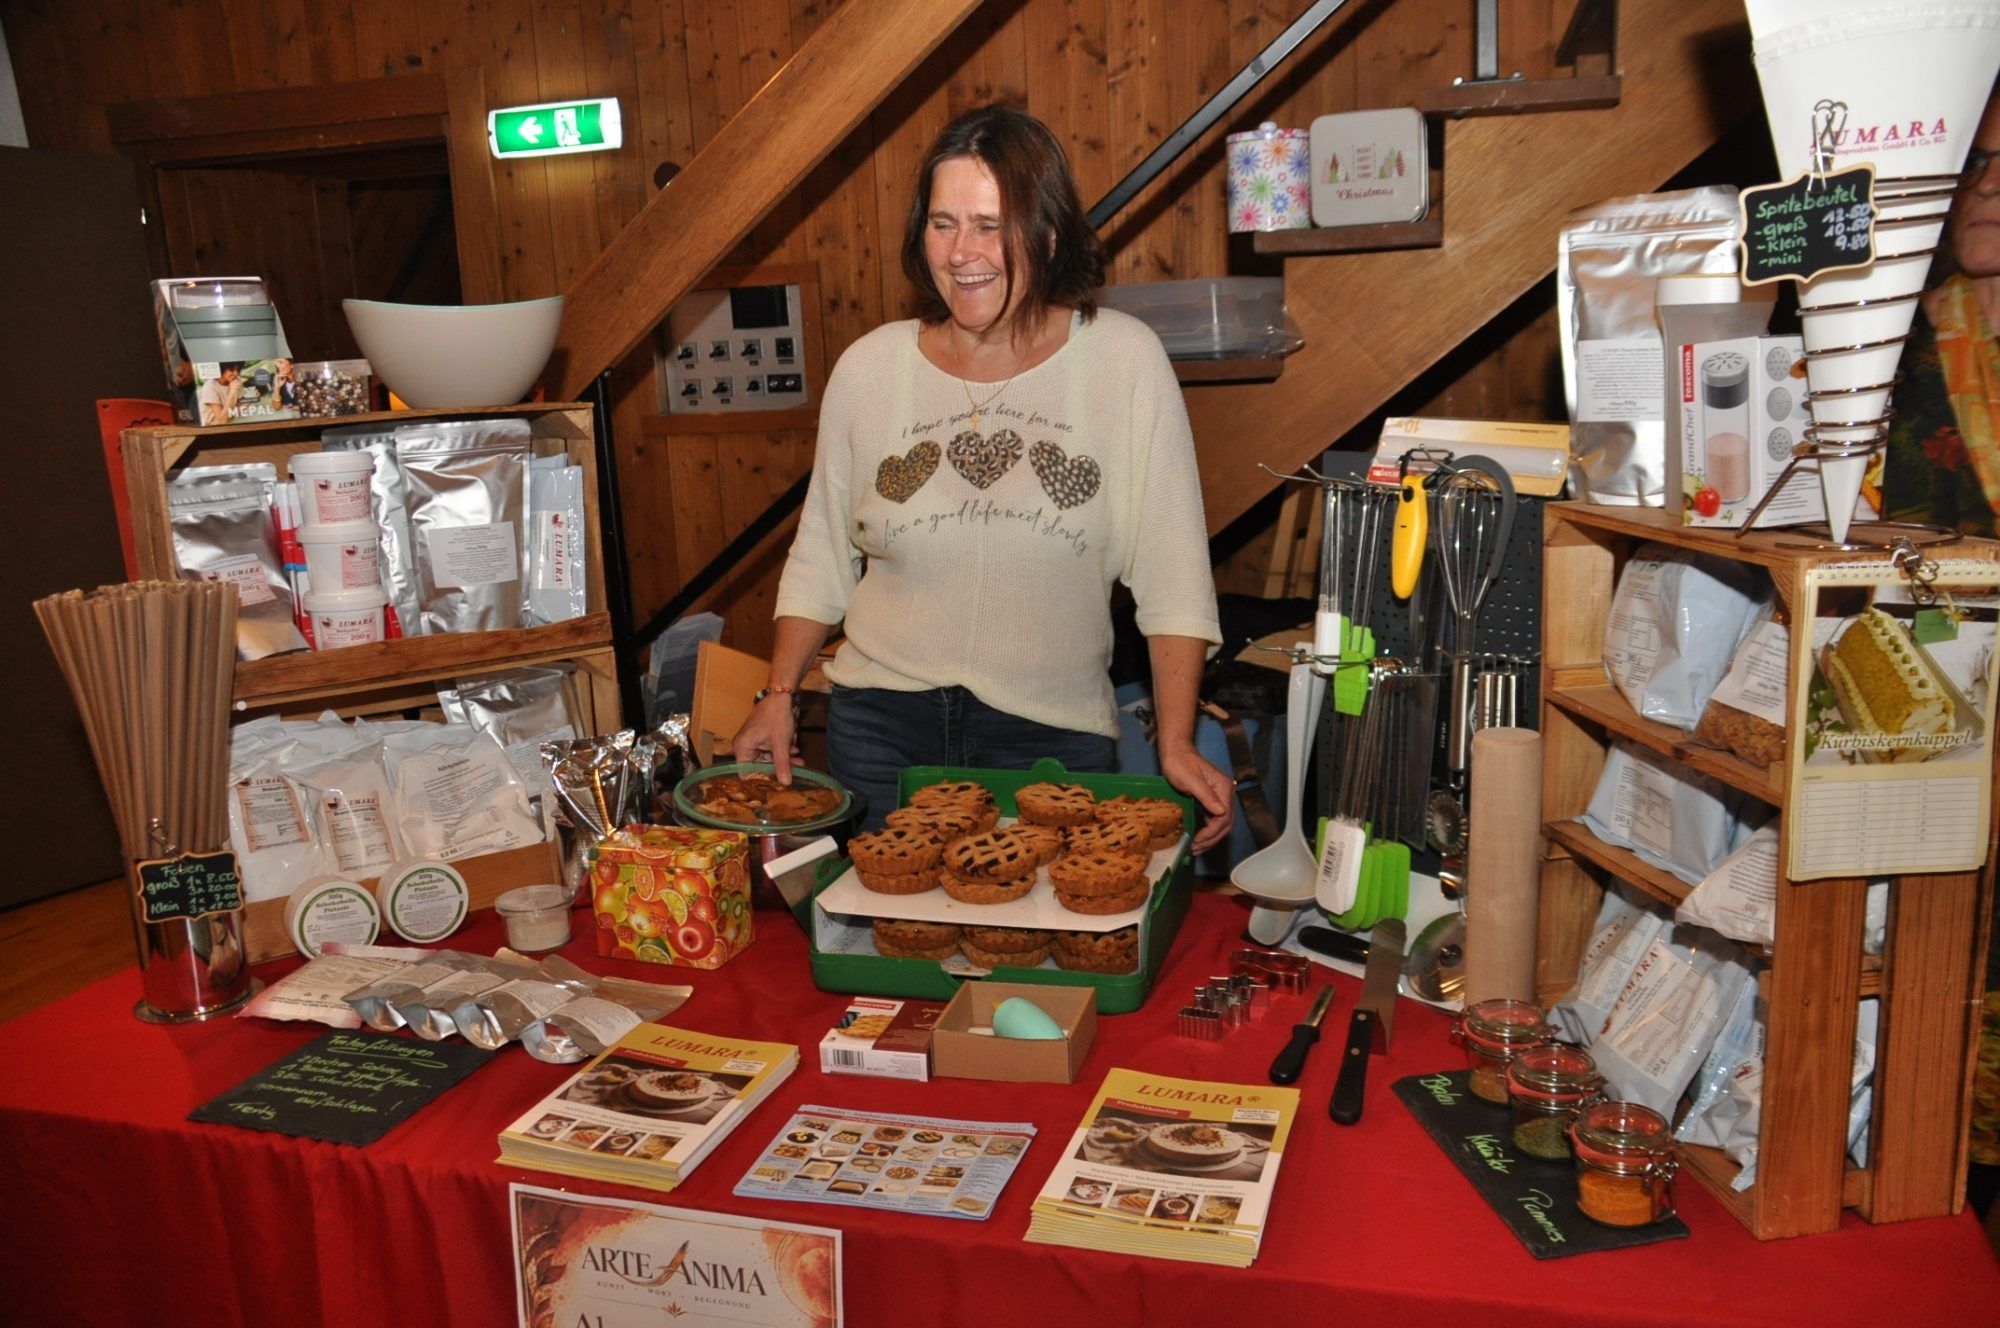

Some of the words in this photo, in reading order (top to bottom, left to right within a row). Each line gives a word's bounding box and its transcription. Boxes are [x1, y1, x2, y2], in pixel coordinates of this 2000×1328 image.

[1337, 188, 1394, 200] Christmas
[1756, 184, 1858, 219] Spritzbeutel
[228, 404, 274, 418] MEPAL
[911, 419, 943, 435] hope
[995, 403, 1024, 419] here
[930, 500, 968, 532] good
[969, 499, 1001, 525] life
[581, 1245, 654, 1280] ARTE
[694, 1296, 751, 1310] BEGEGNUNG
